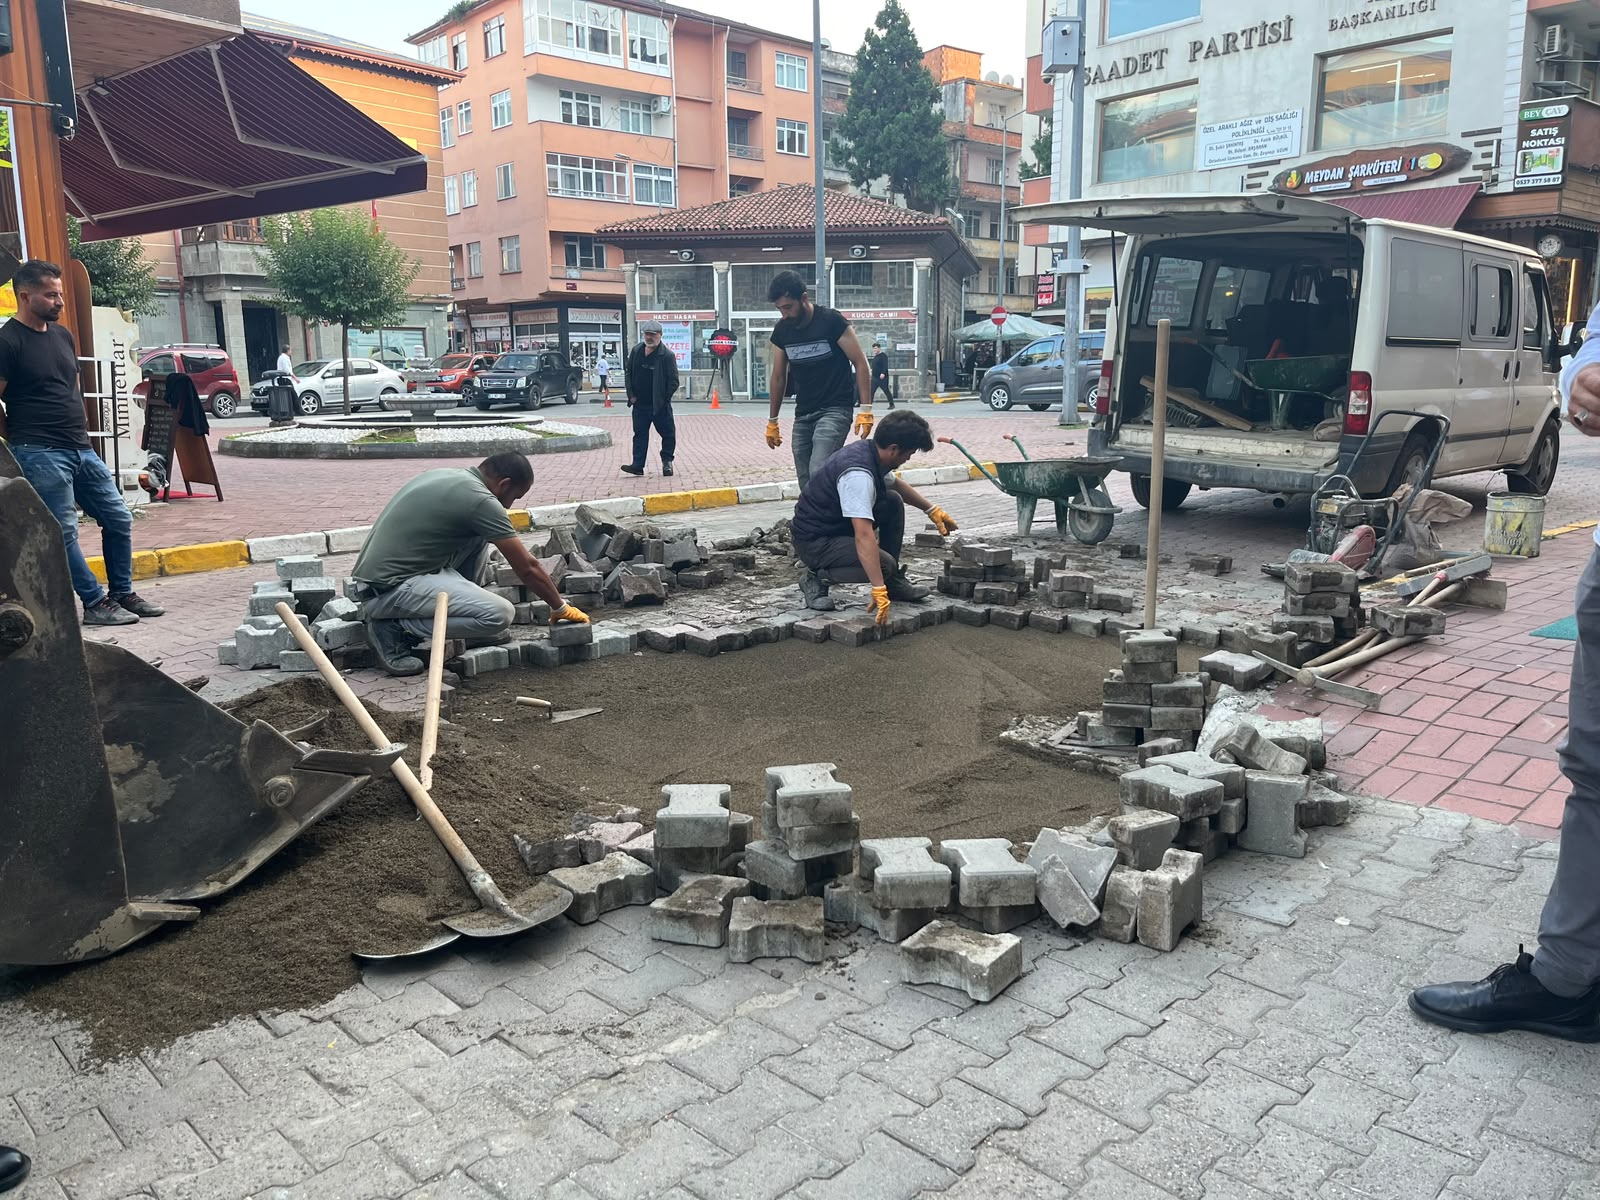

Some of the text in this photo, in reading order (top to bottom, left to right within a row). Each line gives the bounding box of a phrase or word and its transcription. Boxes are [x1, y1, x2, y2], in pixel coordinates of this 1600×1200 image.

[1084, 14, 1294, 86] SAADET PARTİSİ
[1524, 110, 1541, 119] BEY
[1203, 126, 1216, 134] ÖZEL
[1218, 121, 1237, 132] ARAKLI
[1240, 119, 1253, 127] AĞIZ
[1264, 115, 1274, 124] DİŞ
[1275, 111, 1298, 121] SAĞLIĞI
[1231, 125, 1265, 138] POLİKLİNİĞİ
[1530, 127, 1559, 137] SATIŞ
[1522, 137, 1565, 148] NOKTASI
[1304, 167, 1344, 184] MEYDAN
[1347, 156, 1403, 181] ŞARKÜTERİ
